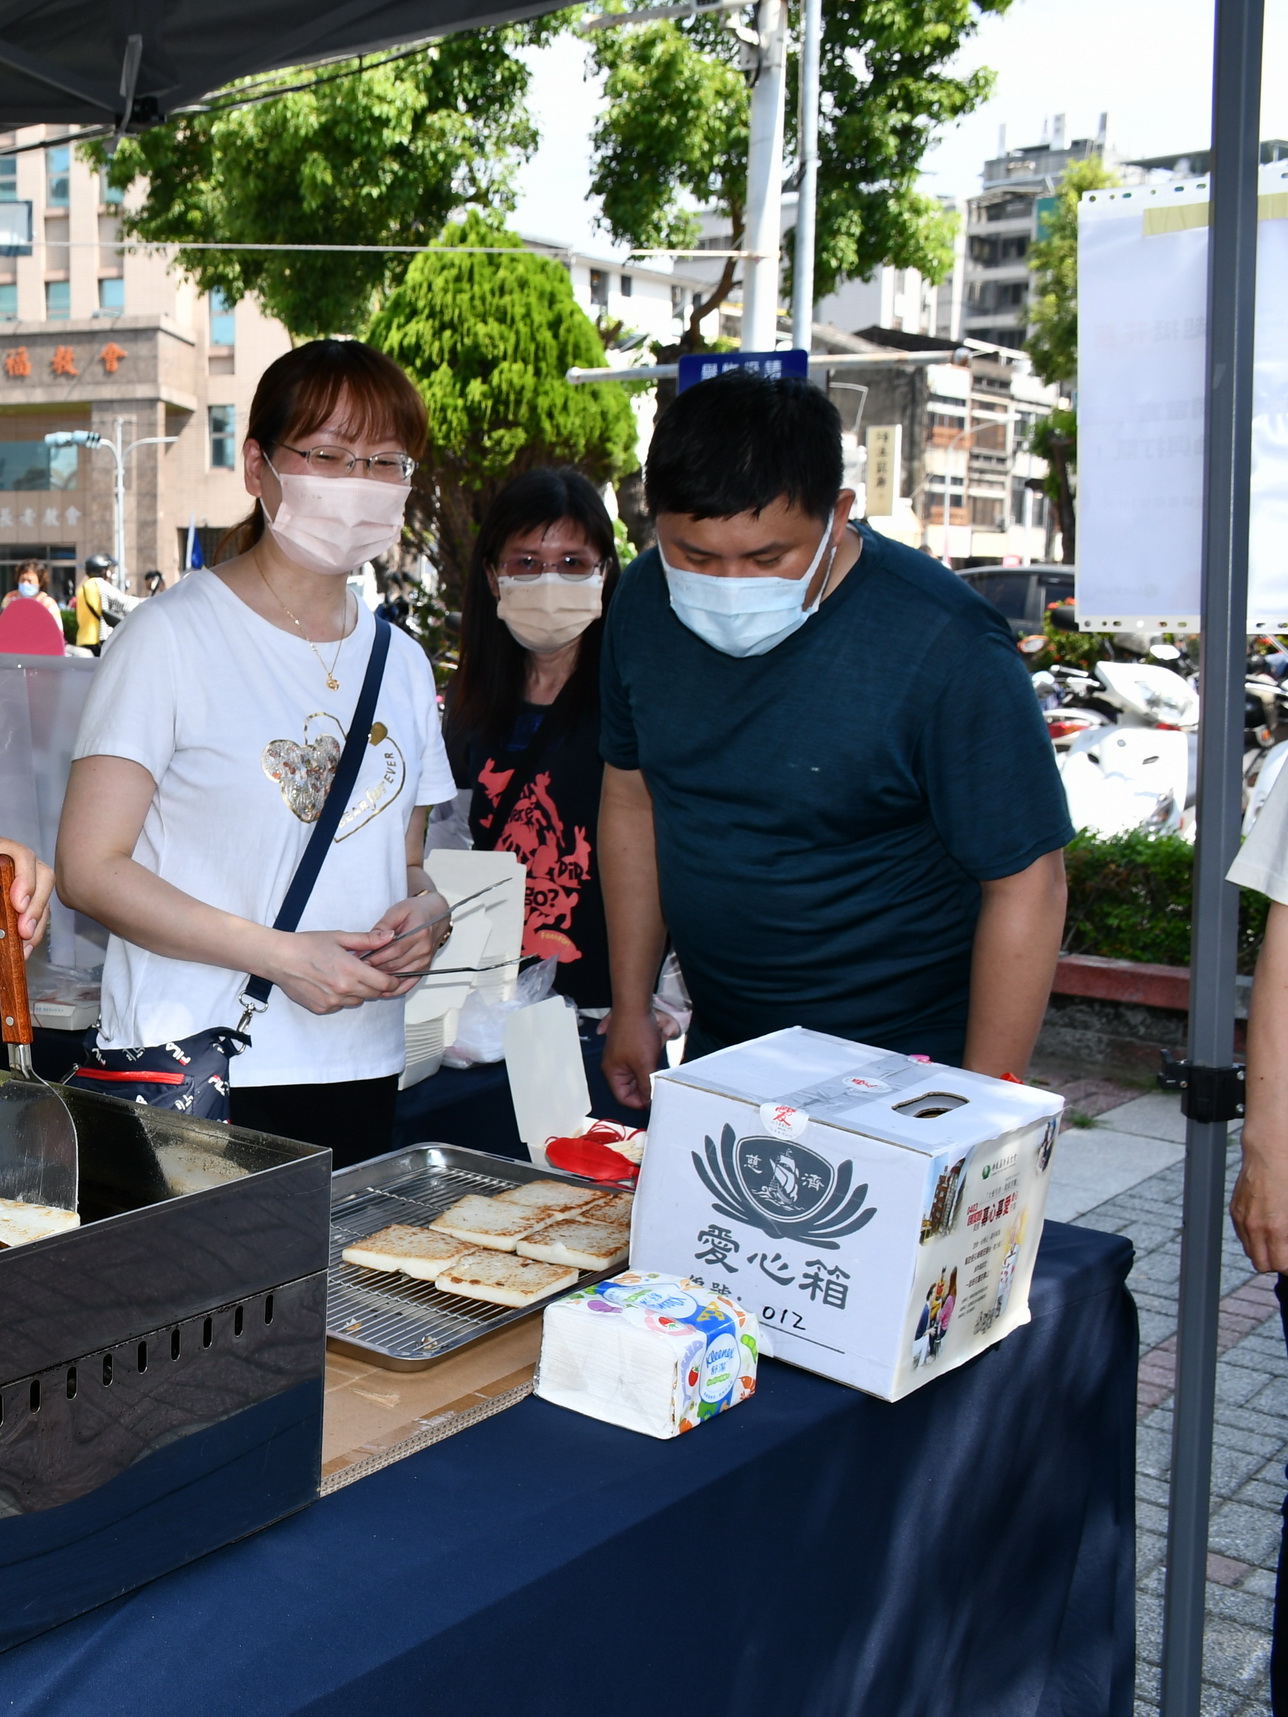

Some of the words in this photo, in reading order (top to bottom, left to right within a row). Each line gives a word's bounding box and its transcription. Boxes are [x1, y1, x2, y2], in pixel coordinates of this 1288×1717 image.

[383, 752, 397, 784] EVER
[165, 1042, 192, 1067] FILA
[743, 1154, 763, 1175] 慈
[801, 1172, 825, 1192] 濟
[688, 1224, 851, 1310] 愛心箱
[762, 1306, 807, 1331] 012
[705, 1347, 735, 1368] Kleenex
